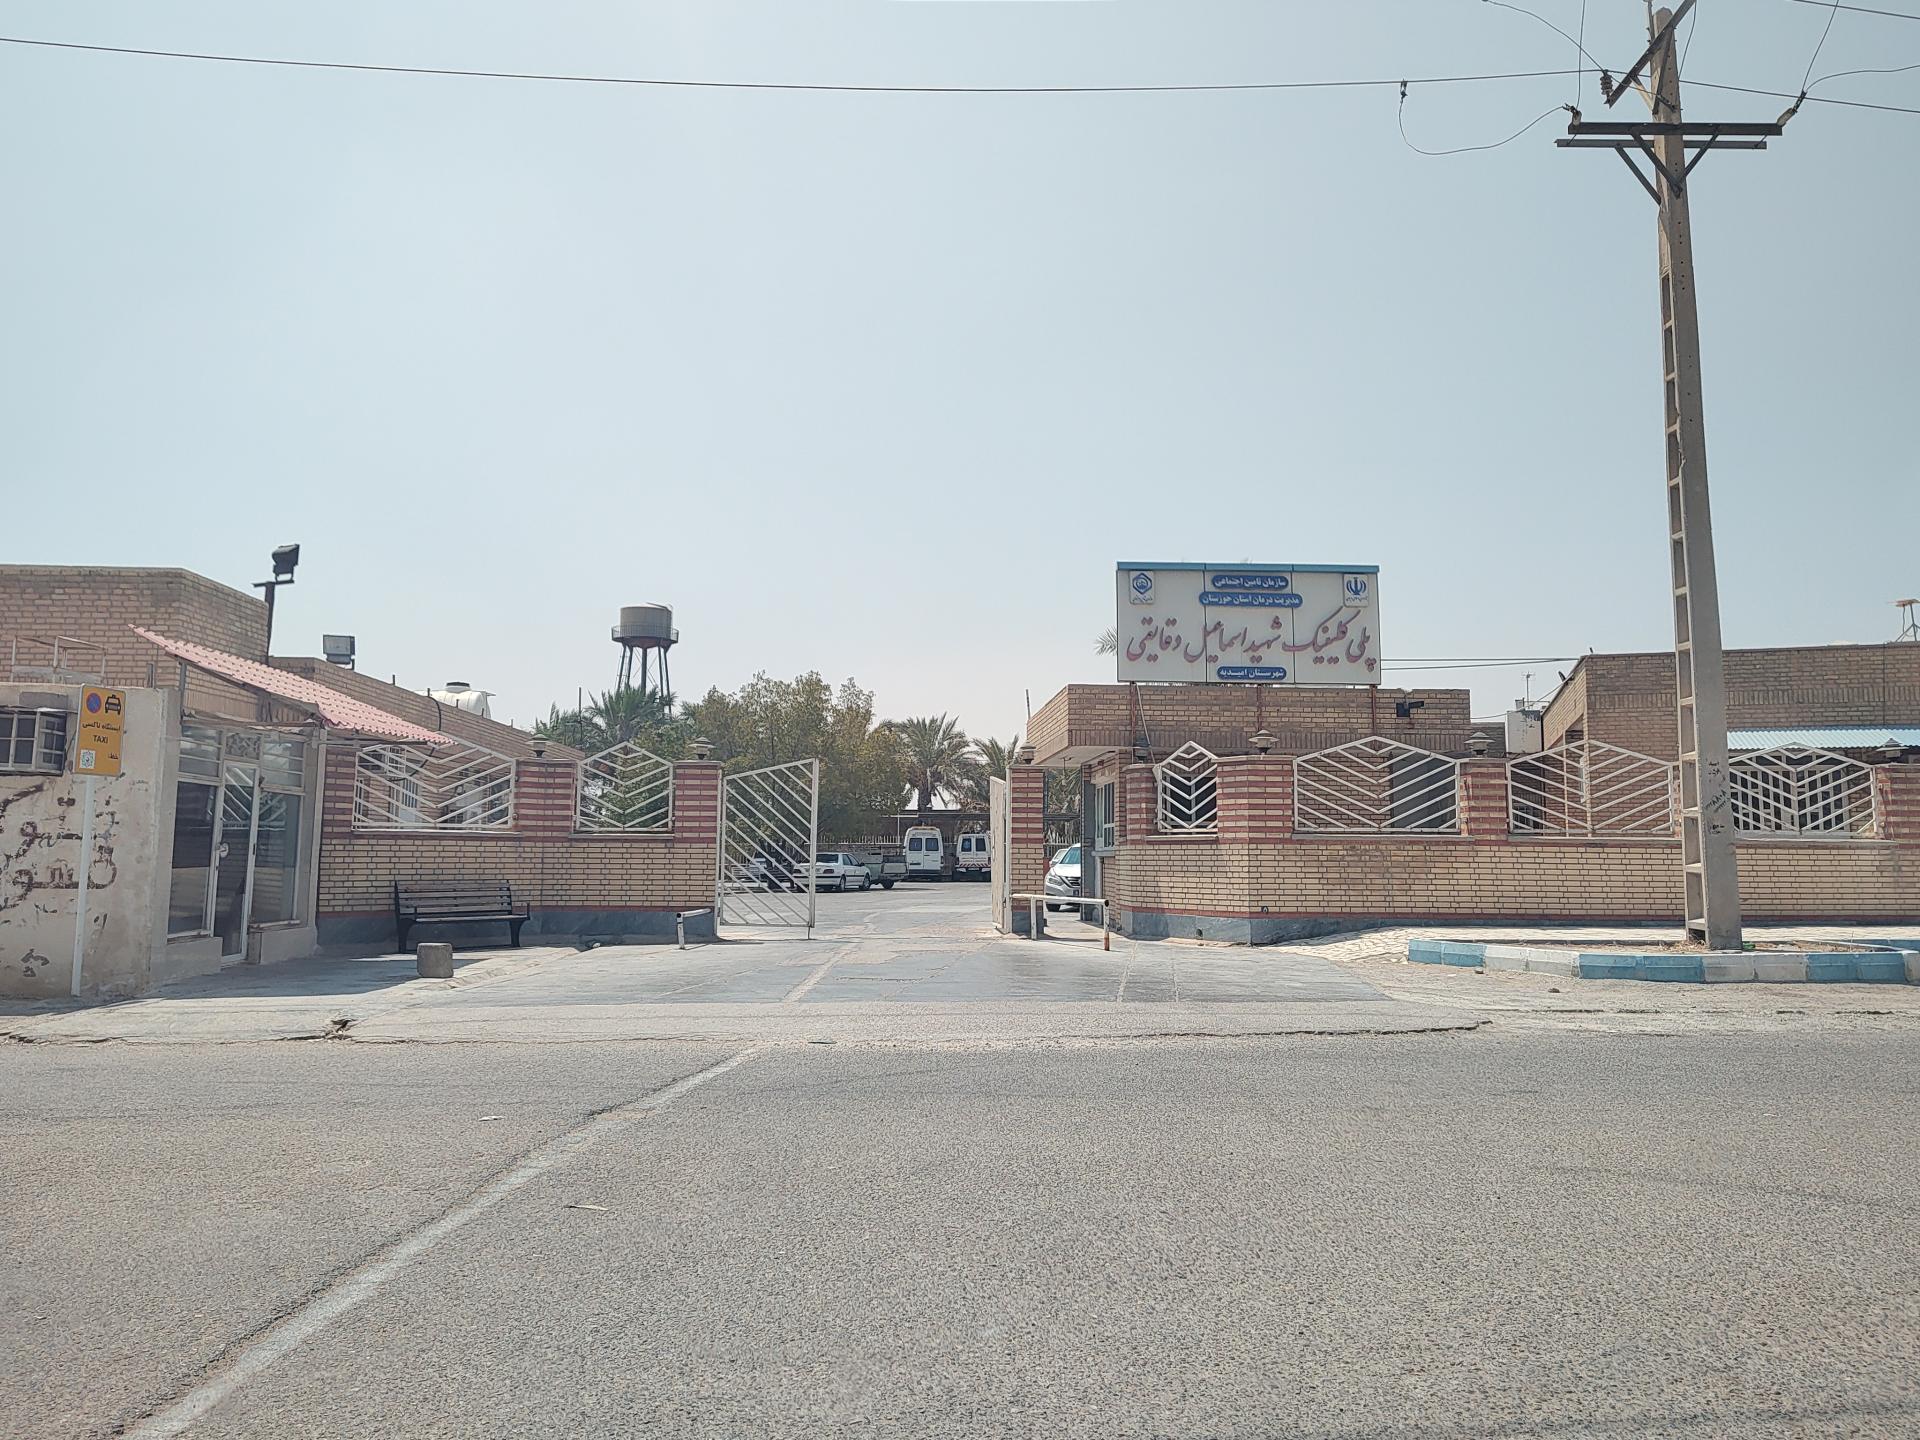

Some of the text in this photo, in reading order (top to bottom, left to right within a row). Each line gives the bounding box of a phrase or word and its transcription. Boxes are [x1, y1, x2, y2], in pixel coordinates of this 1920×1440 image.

[1214, 576, 1244, 587] اجتماعی
[1262, 577, 1287, 588] سازمان
[1202, 593, 1300, 606] مدیریت درمان استان خوزستان
[1126, 606, 1377, 672] پلی کلینیک شهید اسماعیل دقایقی
[1220, 668, 1285, 678] شهرستان امیدیه
[102, 722, 121, 731] ایستگاه
[93, 735, 108, 744] TAXI
